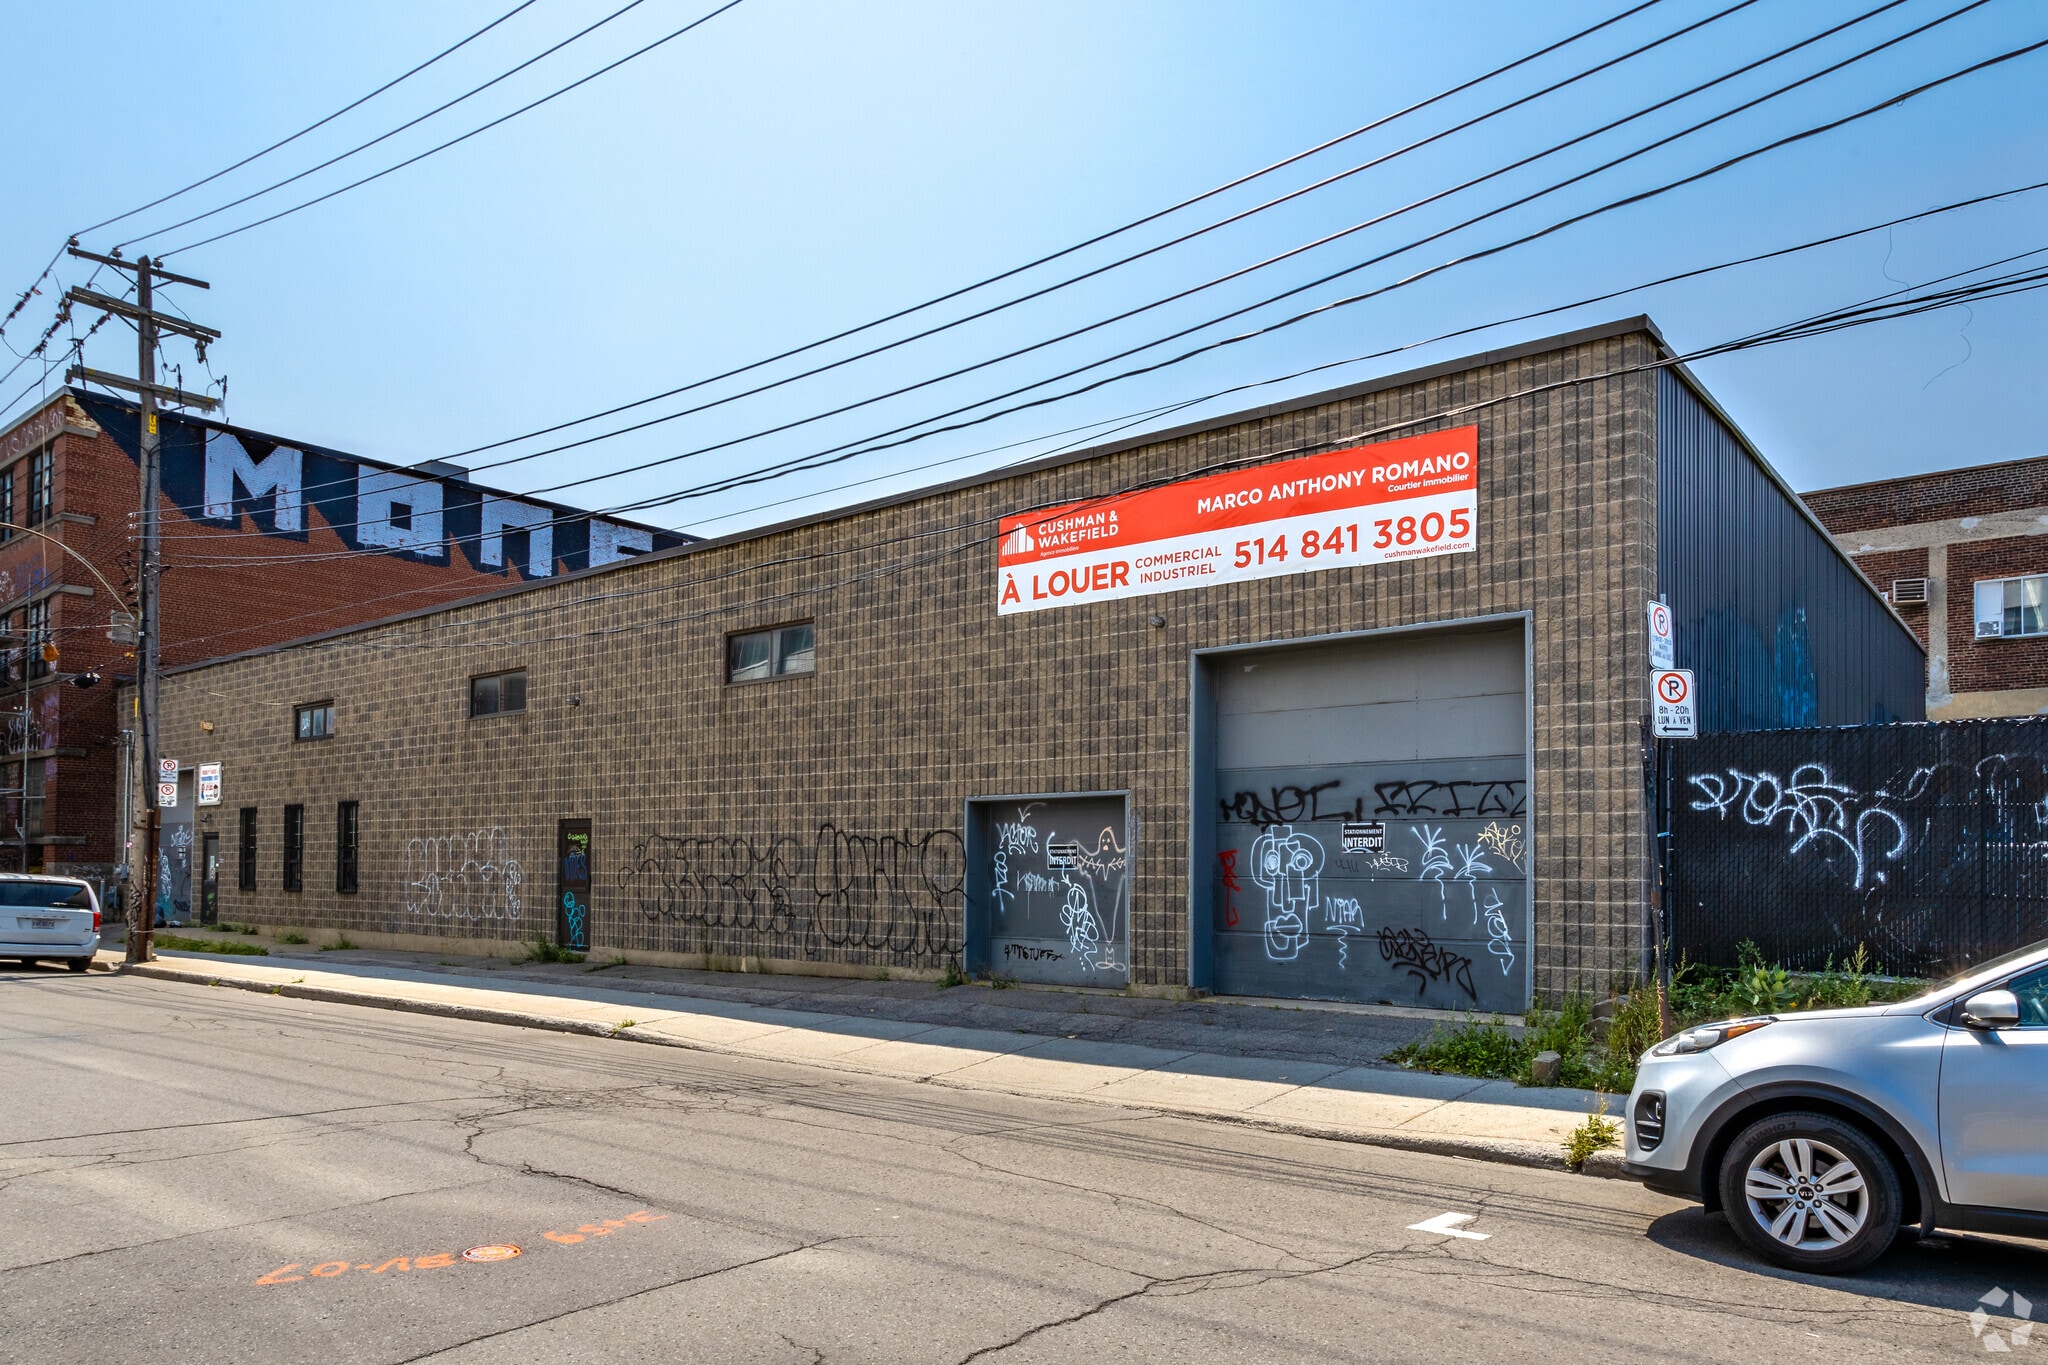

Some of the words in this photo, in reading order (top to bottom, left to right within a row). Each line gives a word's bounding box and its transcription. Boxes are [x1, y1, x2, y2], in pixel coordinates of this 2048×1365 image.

[1197, 488, 1263, 514] MARCO
[1268, 469, 1366, 502] ANTHONY
[1372, 452, 1470, 483] ROMANO
[1387, 480, 1421, 492] Courtier
[1423, 473, 1469, 487] immobilier
[1038, 512, 1105, 535] CUSHMAN
[1109, 510, 1118, 522] &
[1038, 524, 1119, 548] WAKEFIELD
[1234, 534, 1288, 569] 514
[1301, 524, 1358, 558] 841
[1373, 508, 1470, 549] 3805
[1040, 549, 1055, 557] Agence
[1135, 546, 1222, 569] COMMERCIAL
[1384, 542, 1470, 559] cushmanwakefield.com
[1001, 572, 1021, 605] À
[1033, 560, 1129, 600] LOUER
[1140, 563, 1216, 584] INDUSTRIEL
[1659, 705, 1669, 714] 8h
[1675, 705, 1689, 714] 20h
[1658, 715, 1670, 724] LUN
[1679, 715, 1691, 724] VEN
[1344, 824, 1382, 834] STATIONNEMENT
[1344, 837, 1382, 848] INTERDIT
[1049, 856, 1077, 865] INTERDIT
